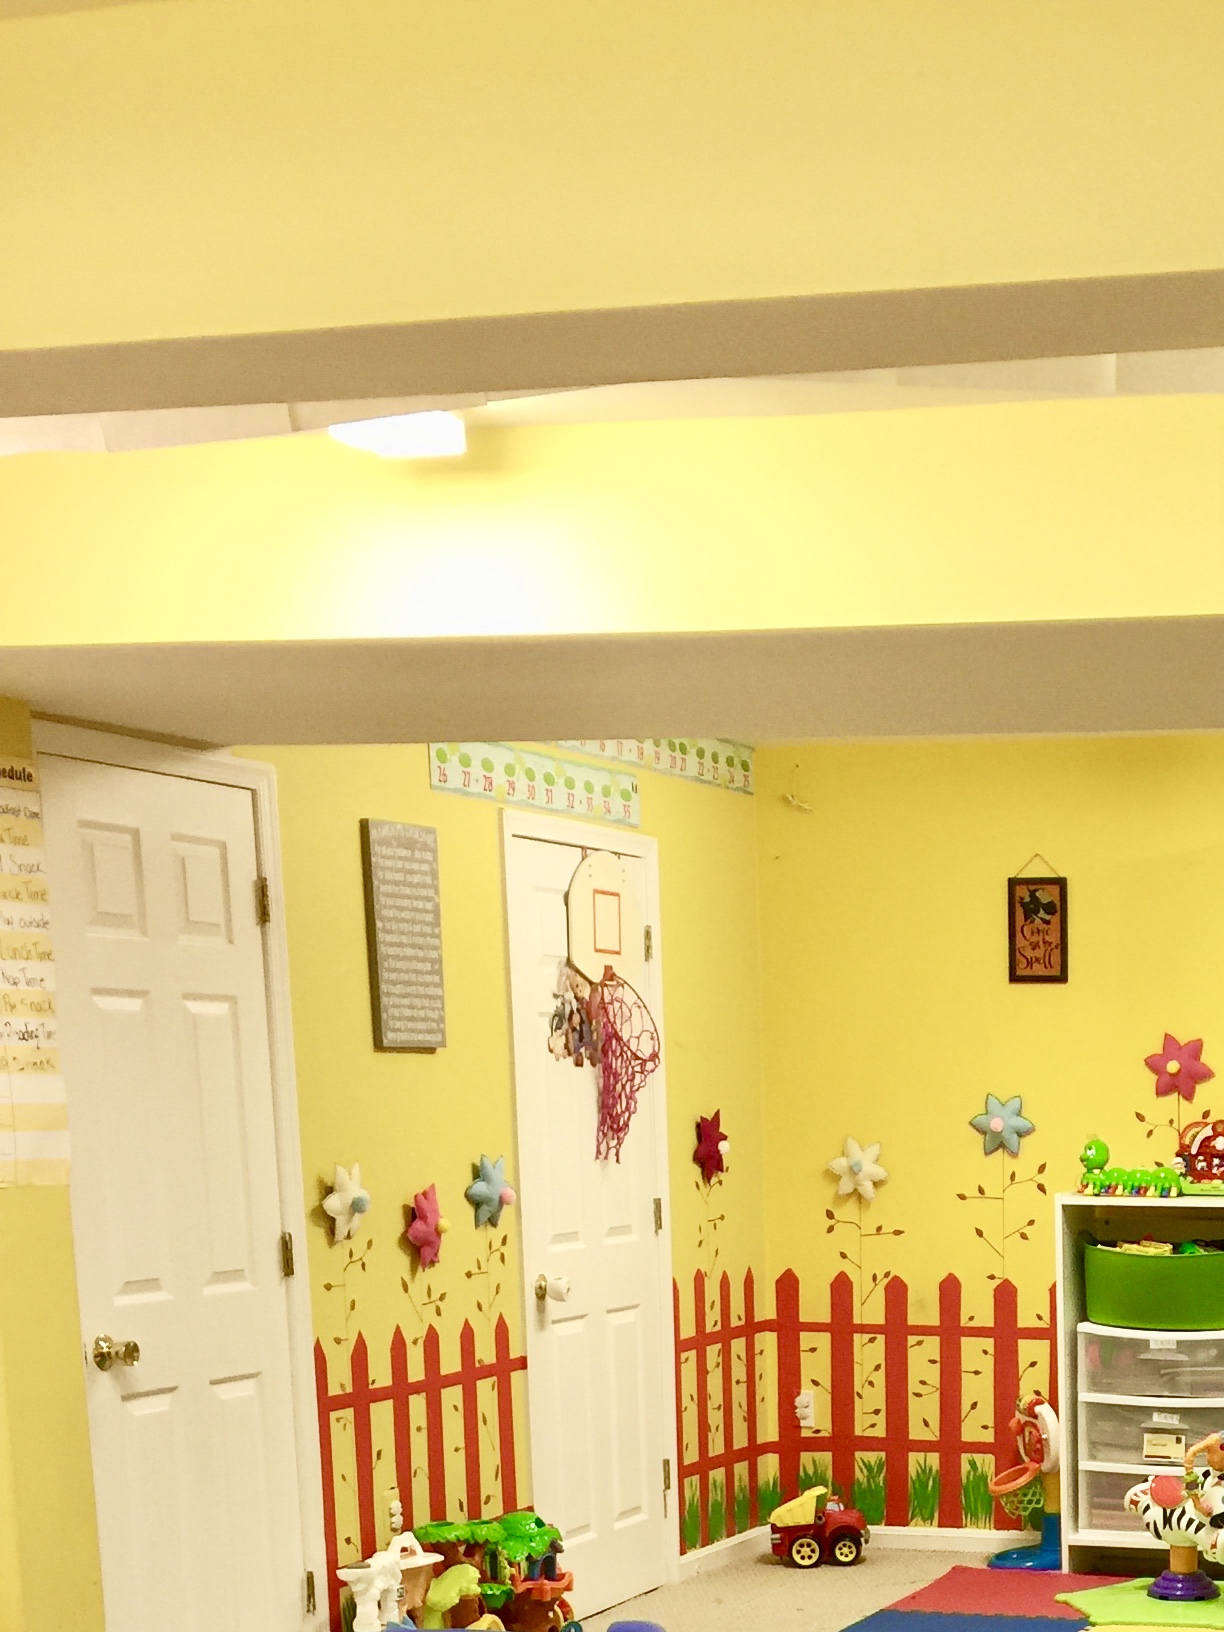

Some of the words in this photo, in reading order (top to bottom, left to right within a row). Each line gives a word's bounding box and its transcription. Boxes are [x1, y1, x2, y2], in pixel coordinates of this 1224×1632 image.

[0, 766, 33, 782] edule
[437, 765, 448, 784] 26
[462, 770, 471, 787] 27
[482, 774, 494, 792] 28
[506, 779, 516, 796] 29
[527, 783, 536, 800] 30
[545, 788, 553, 804] 31
[567, 792, 575, 809] 32
[586, 796, 594, 813] 33
[603, 800, 612, 816] 34
[622, 804, 631, 819] 35
